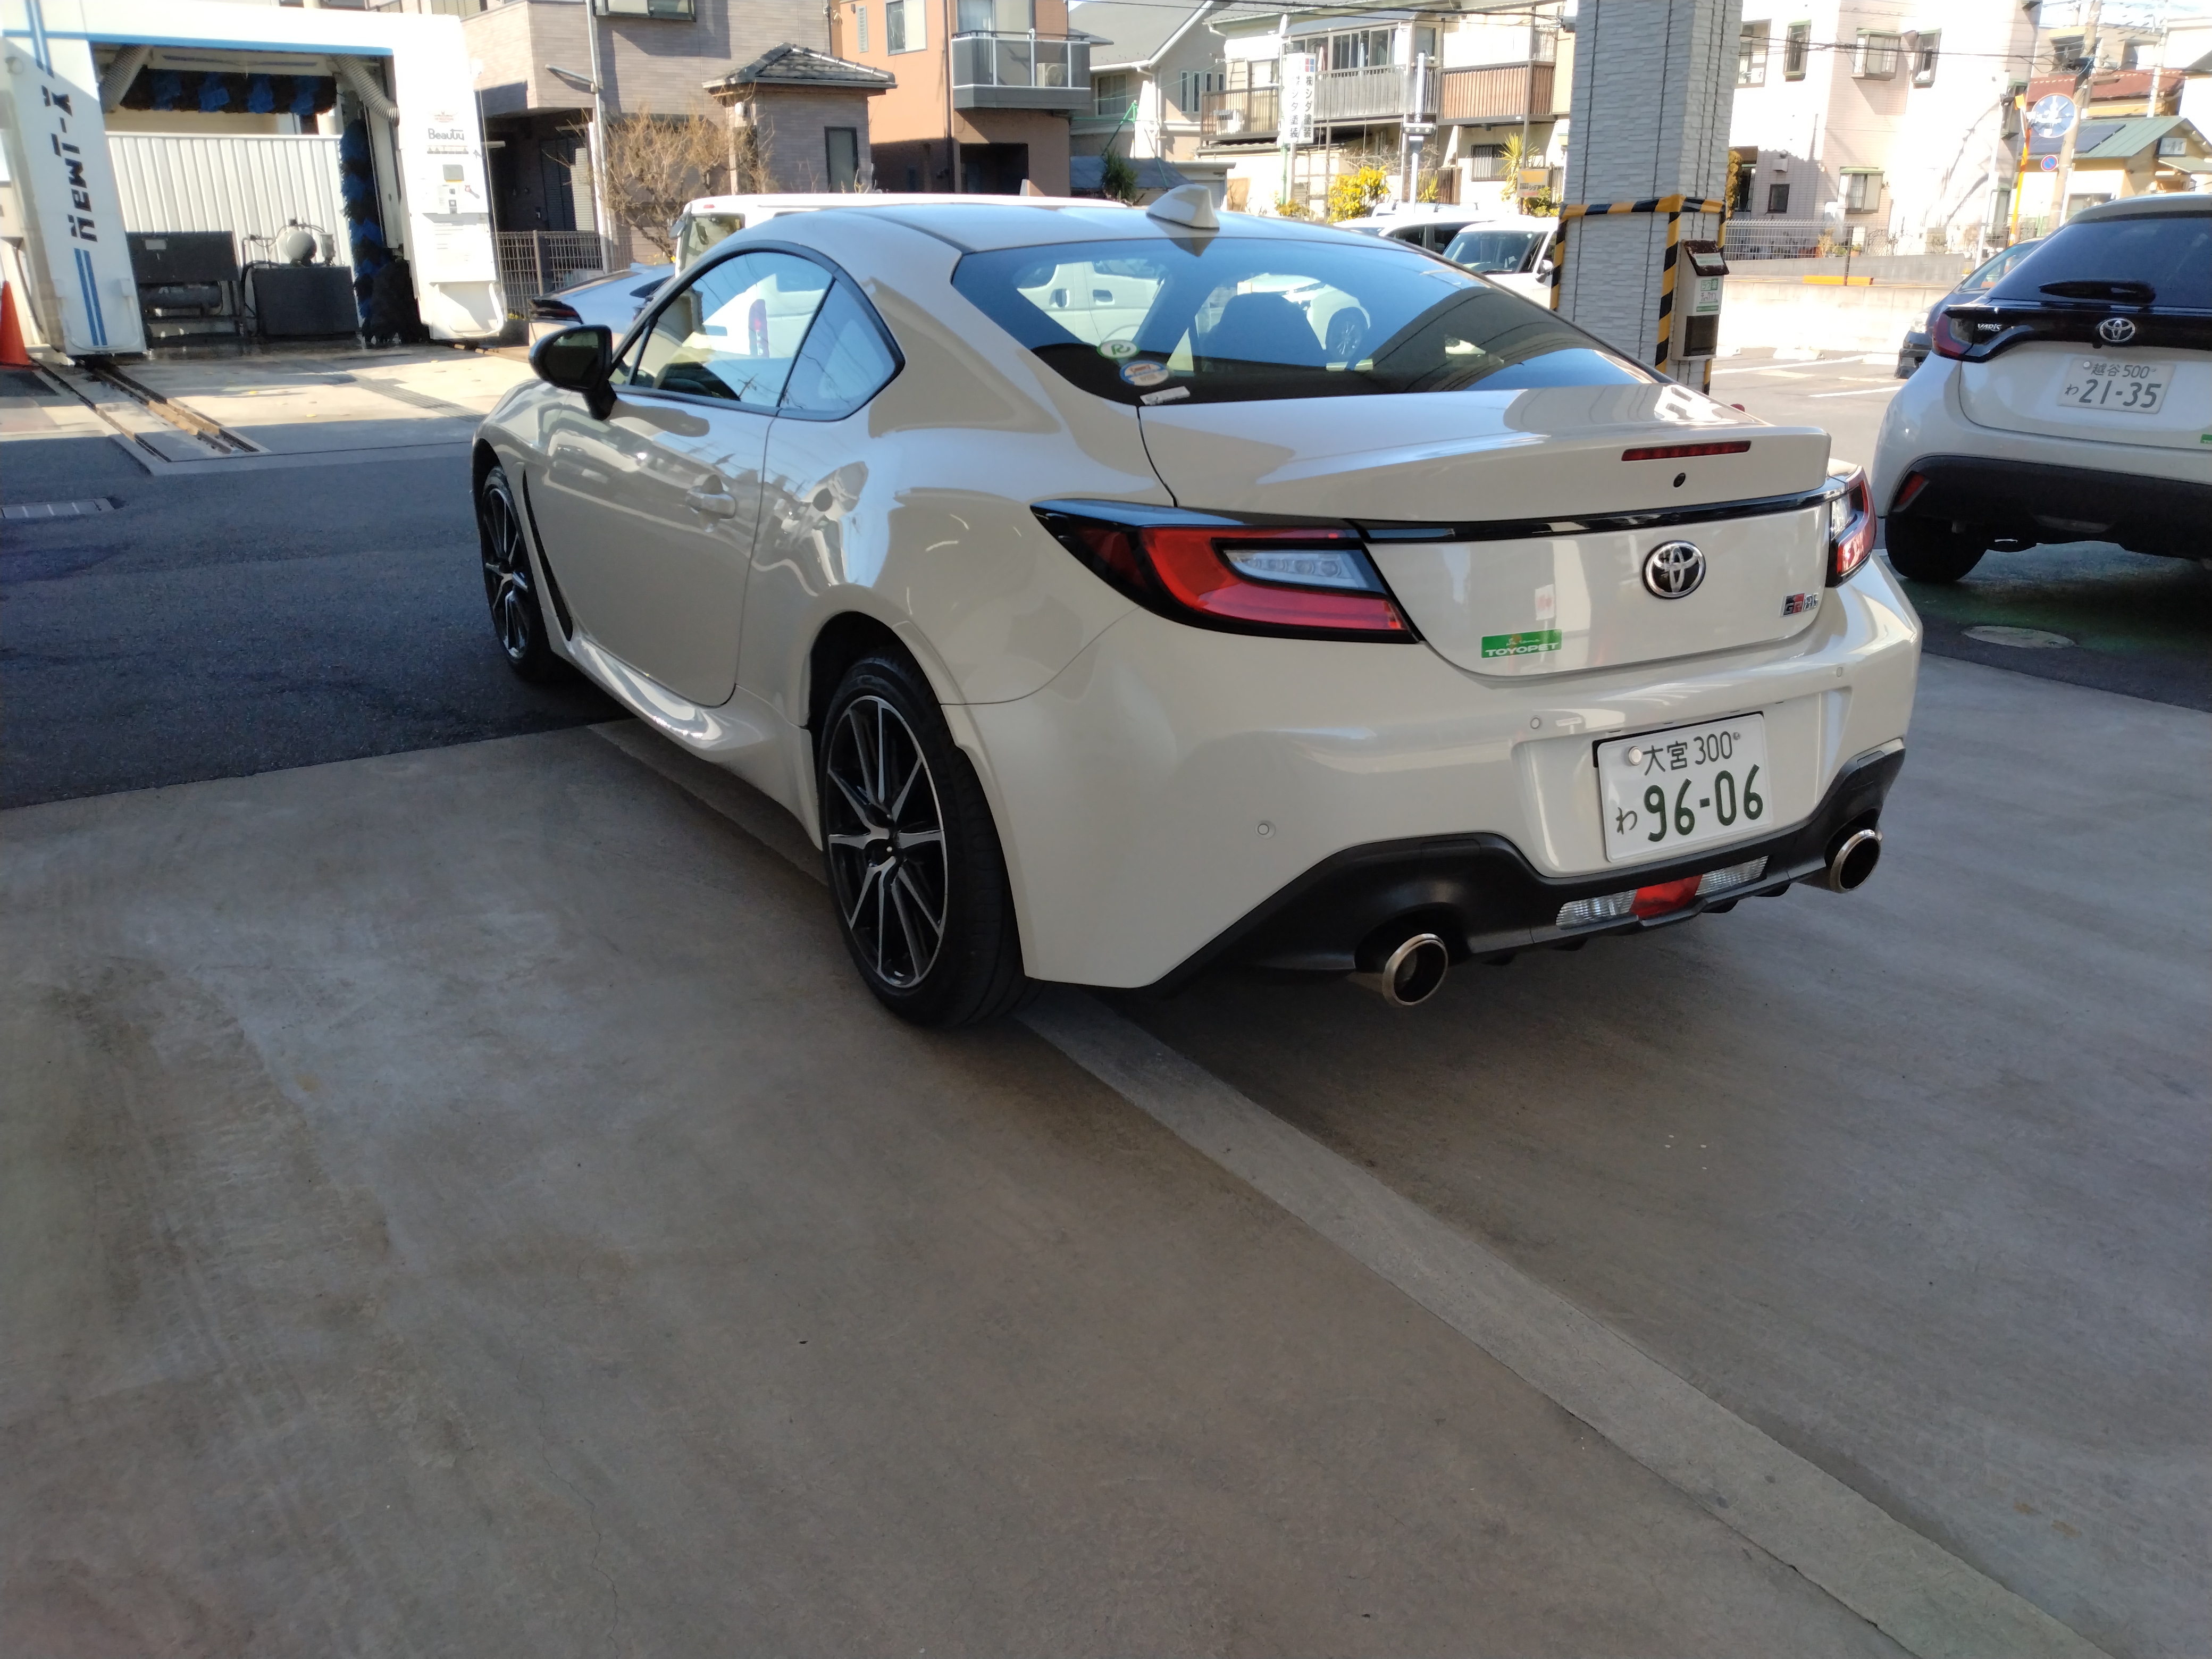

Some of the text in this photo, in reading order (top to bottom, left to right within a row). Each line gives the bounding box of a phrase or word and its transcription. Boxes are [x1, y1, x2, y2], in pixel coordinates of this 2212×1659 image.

[2091, 363, 2150, 379] 越谷 500
[2064, 378, 2162, 408] わ 21-35
[1485, 642, 1559, 657] TOYOPET
[1643, 731, 1732, 776] 大宮 300
[1615, 764, 1763, 842] わ 96-06
